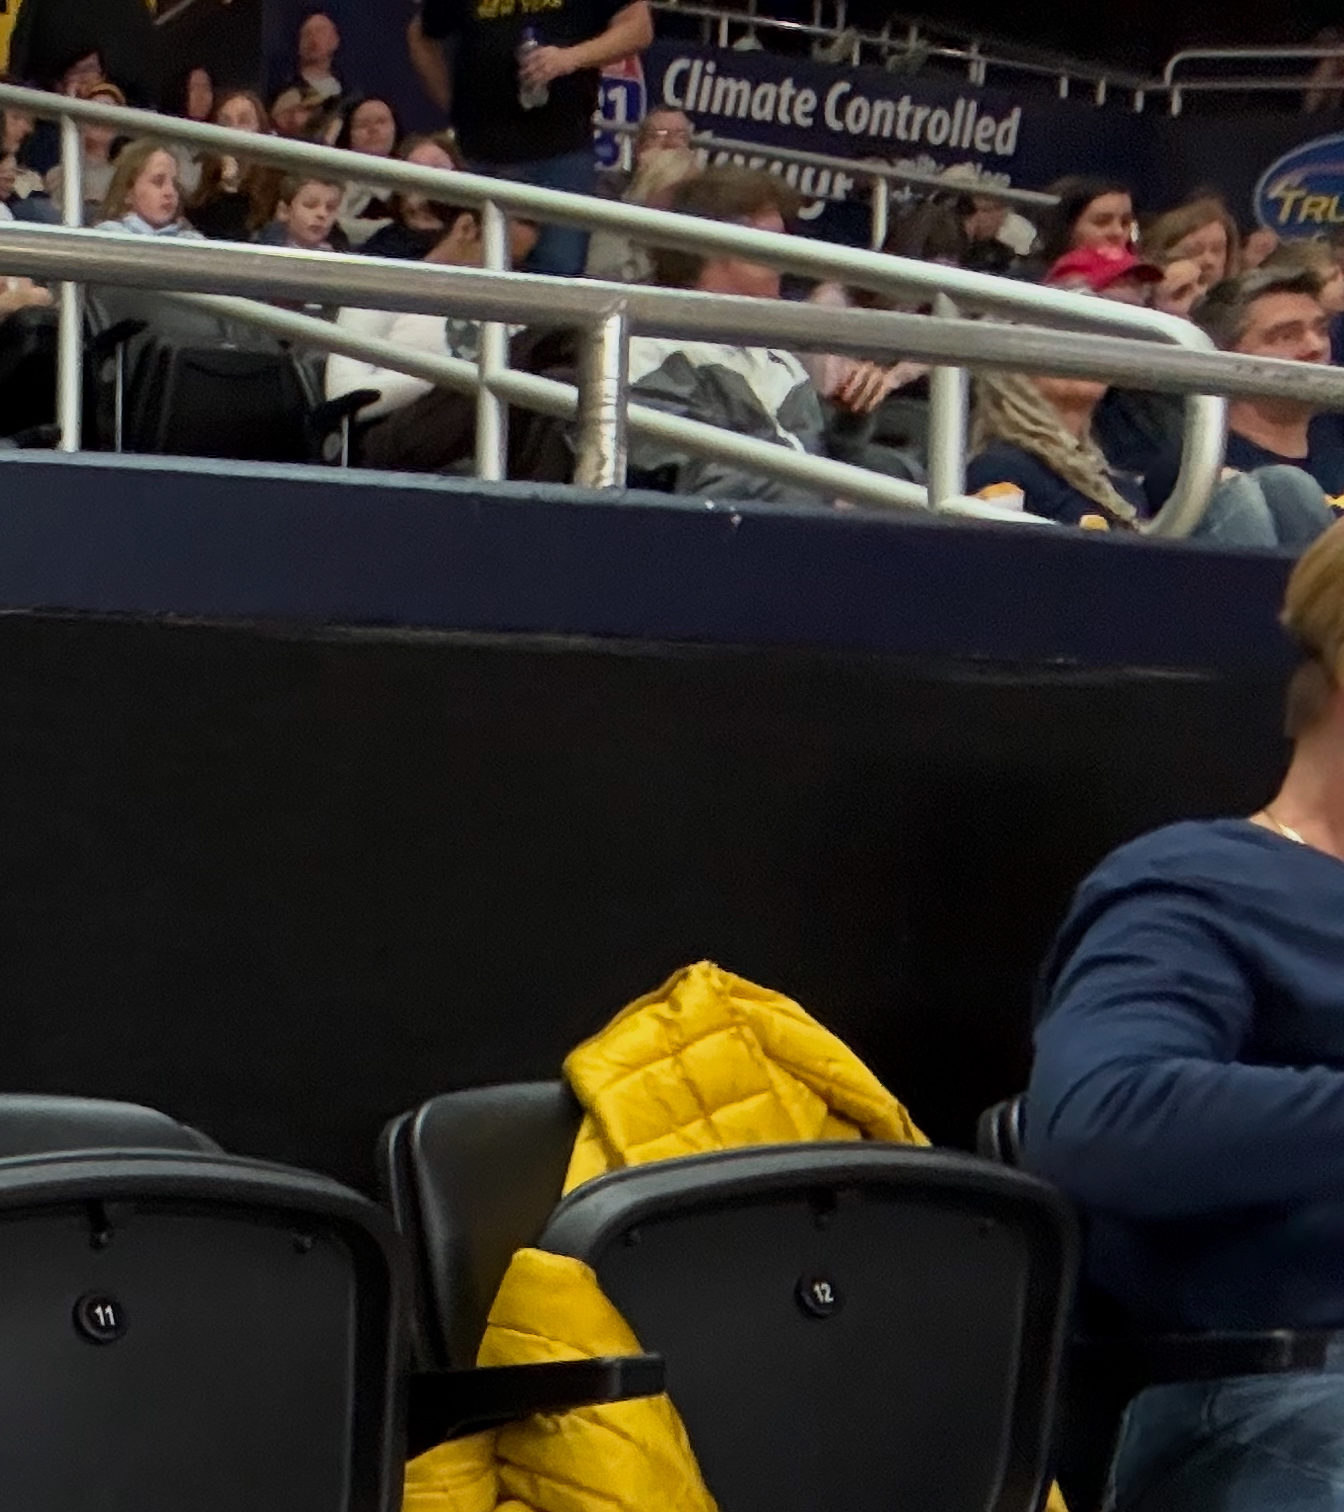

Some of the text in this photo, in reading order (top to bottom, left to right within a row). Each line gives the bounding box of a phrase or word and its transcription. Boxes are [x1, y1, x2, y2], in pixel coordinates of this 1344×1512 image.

[663, 58, 1022, 156] Climate Controlled
[814, 1282, 834, 1303] 12
[94, 1304, 115, 1327] 11
